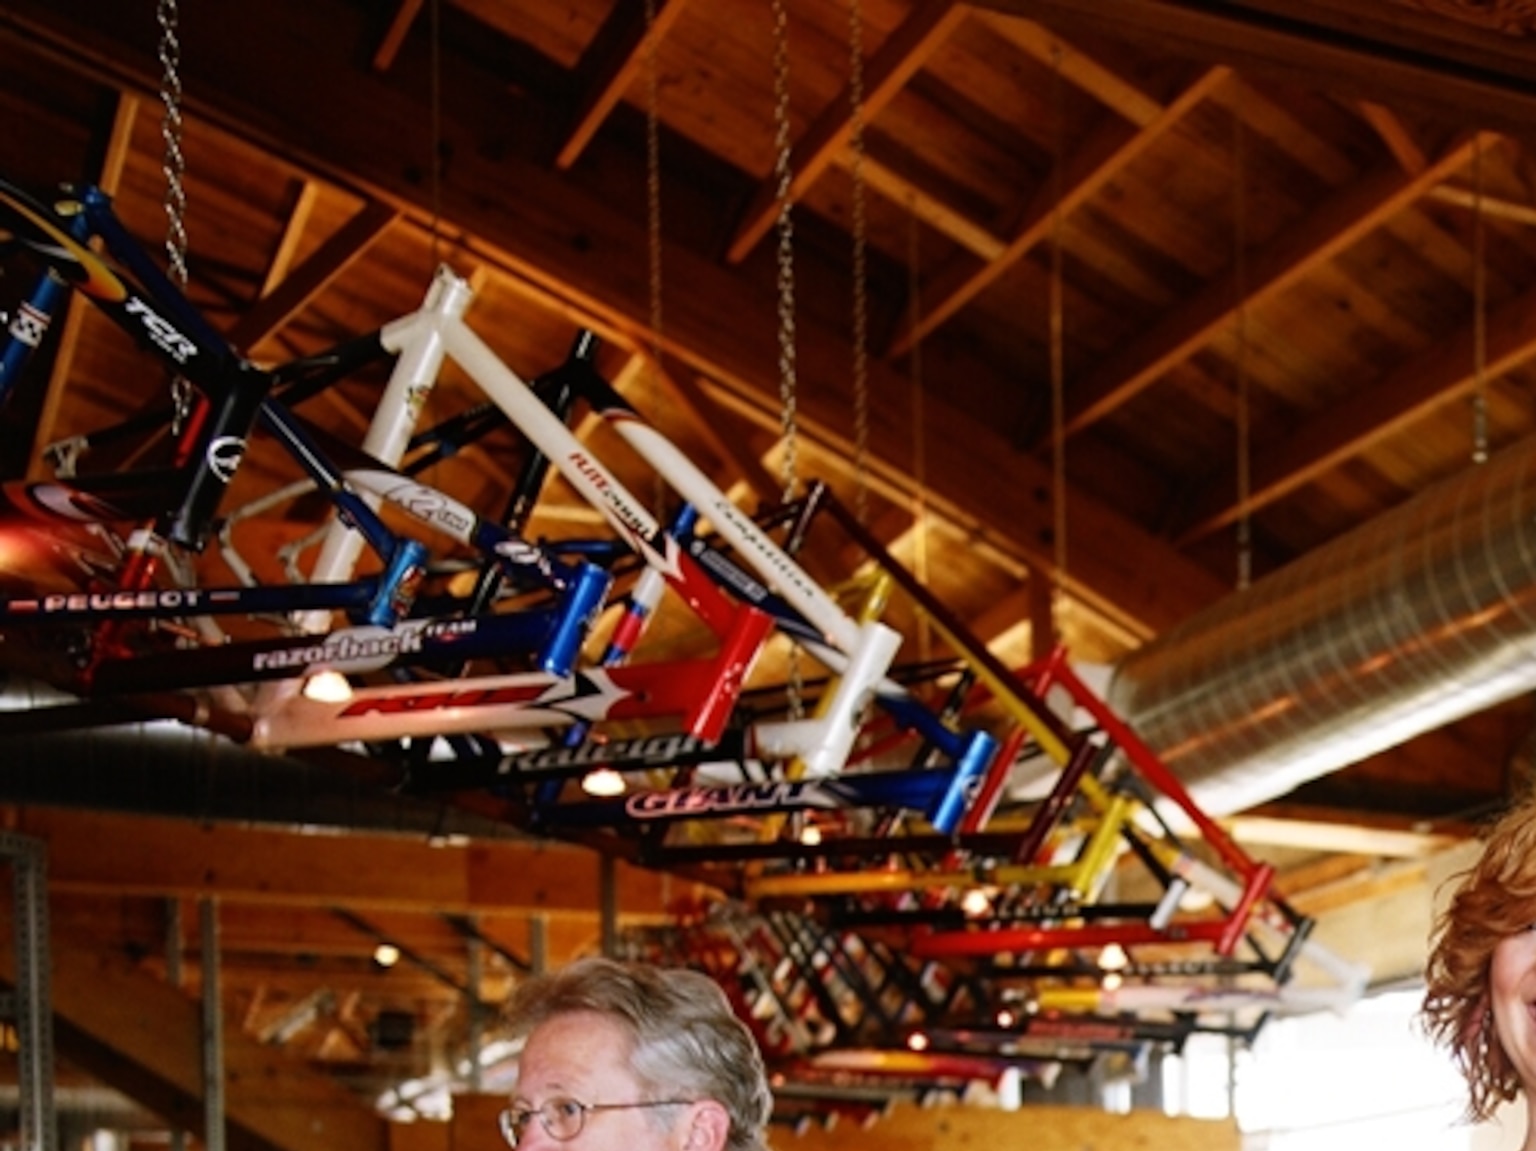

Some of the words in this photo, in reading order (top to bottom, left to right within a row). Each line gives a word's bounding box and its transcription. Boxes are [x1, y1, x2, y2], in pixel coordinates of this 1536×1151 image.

[125, 296, 198, 355] TCR
[714, 500, 815, 598] Competition
[44, 591, 202, 613] PEUGEOT
[253, 625, 422, 670] razorback
[427, 620, 477, 641] TEAM
[625, 780, 812, 818] GIANT
